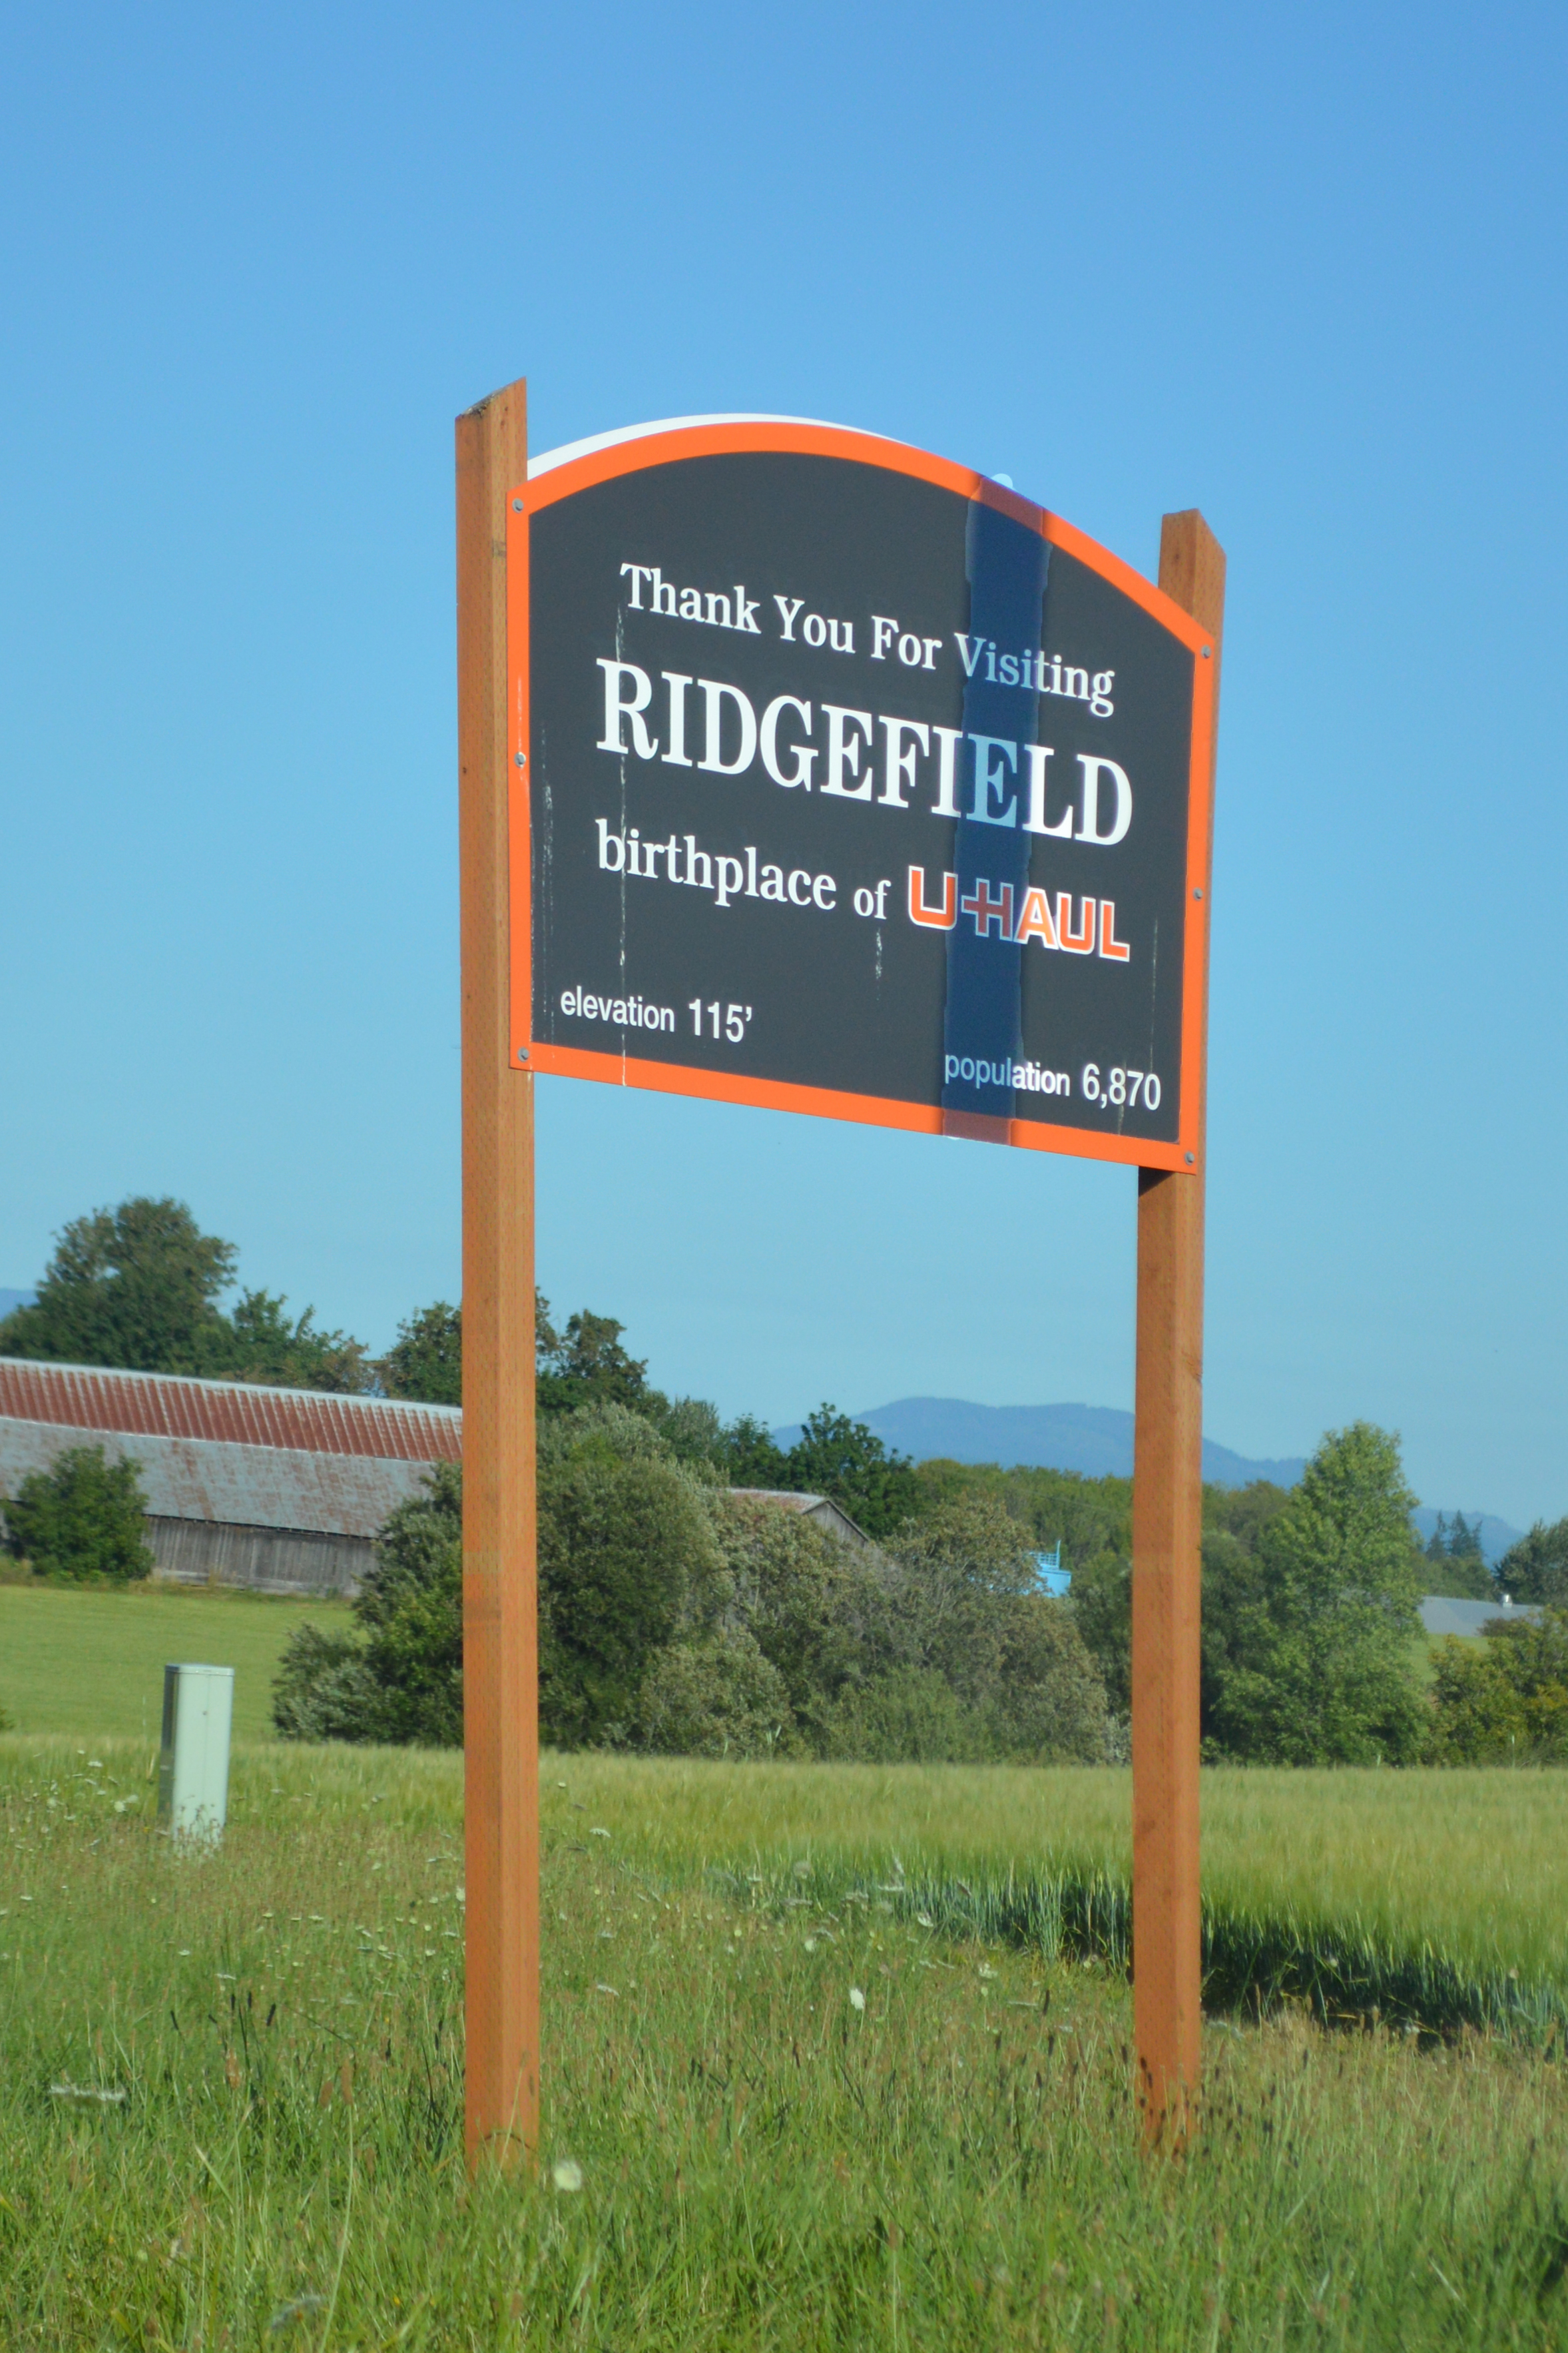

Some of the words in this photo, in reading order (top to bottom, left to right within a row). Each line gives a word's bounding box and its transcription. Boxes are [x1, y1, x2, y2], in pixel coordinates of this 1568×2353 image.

[621, 563, 762, 635] Thank
[773, 595, 854, 654] You
[871, 615, 941, 670] For
[954, 633, 1115, 717] Visiting
[596, 658, 1133, 846] RIDGEFIELD
[596, 819, 836, 907] birthplace
[854, 881, 892, 919] of
[908, 865, 1130, 962] U-HAUL
[560, 986, 675, 1032] elevation
[944, 1054, 1070, 1097] population
[1083, 1064, 1161, 1111] 6,870
